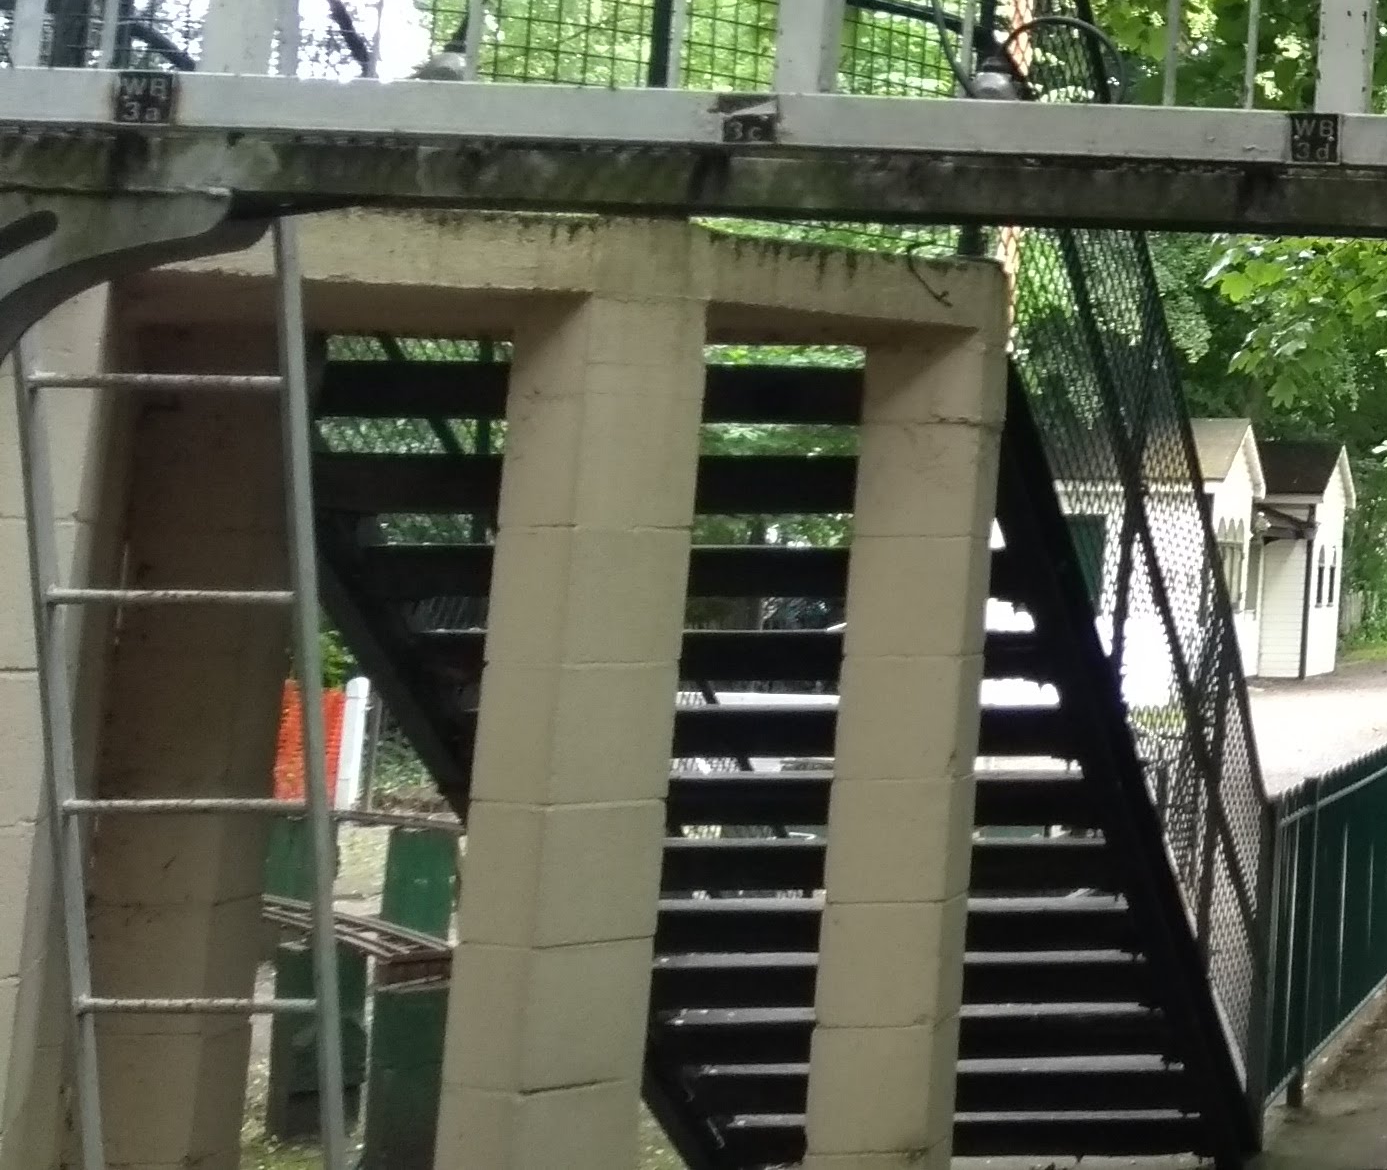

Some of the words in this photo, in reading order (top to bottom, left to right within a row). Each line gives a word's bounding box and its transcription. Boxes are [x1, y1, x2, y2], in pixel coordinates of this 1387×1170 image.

[122, 77, 166, 97] WB
[1294, 119, 1334, 137] WB
[1296, 142, 1329, 160] 3d
